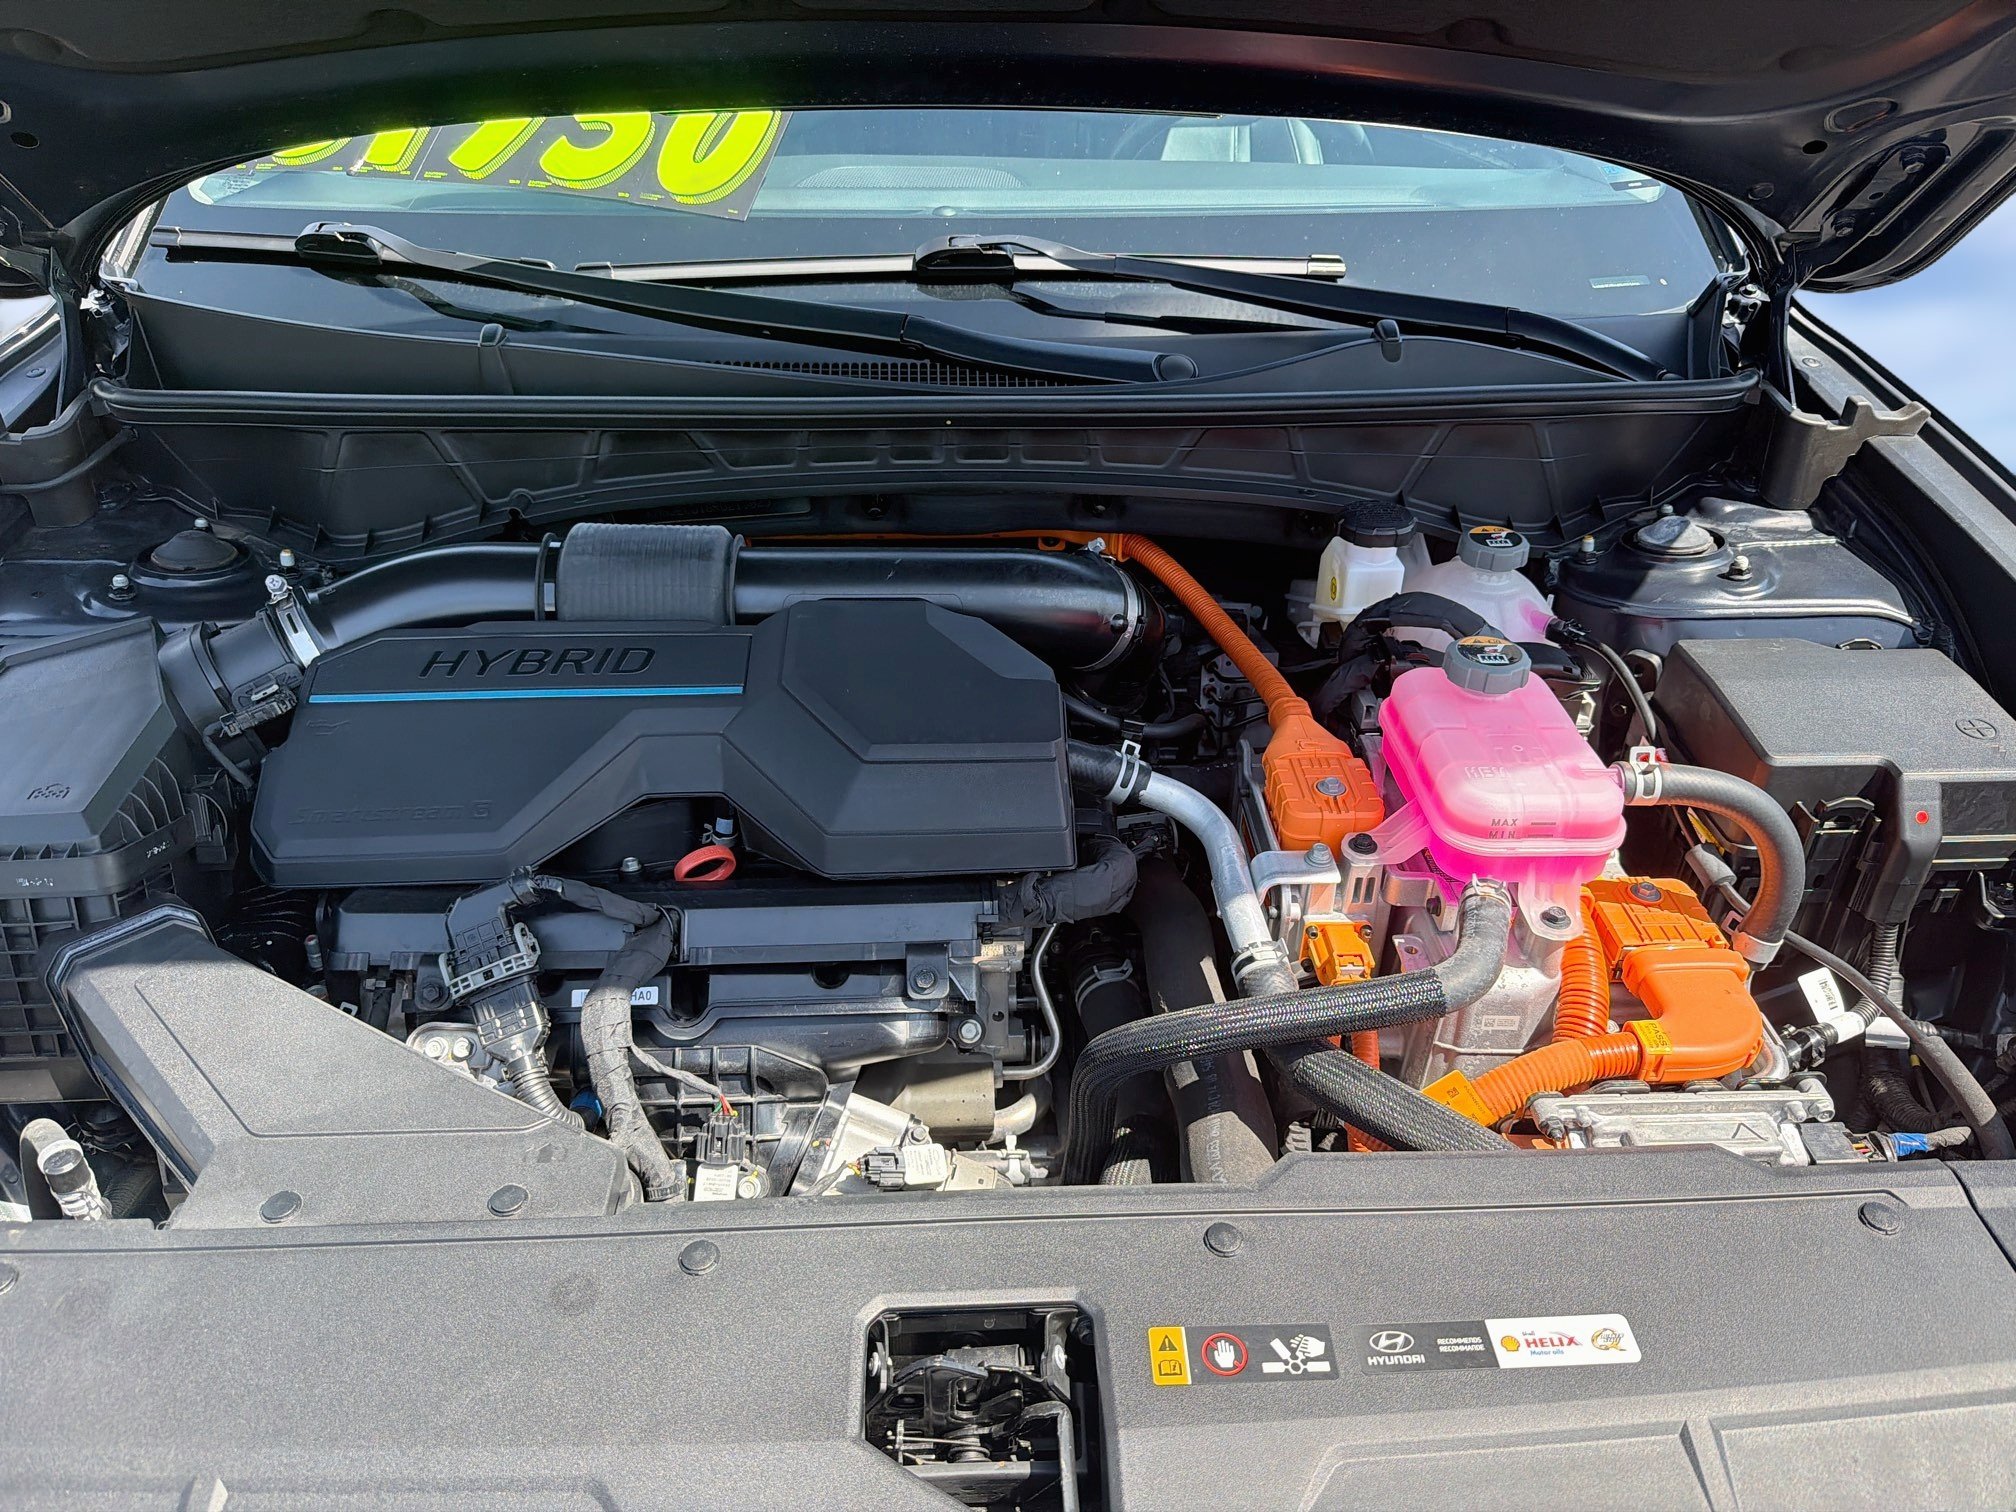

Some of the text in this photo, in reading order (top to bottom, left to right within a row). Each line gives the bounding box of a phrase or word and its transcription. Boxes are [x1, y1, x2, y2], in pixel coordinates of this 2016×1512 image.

[417, 647, 657, 678] HYBRID
[1491, 818, 1518, 827] MAX
[1488, 831, 1516, 839] MIN
[1648, 1022, 1668, 1047] PASS
[1437, 1337, 1482, 1345] RECOMMENDS
[1524, 1336, 1581, 1348] HELIX
[1367, 1354, 1426, 1365] HYUNDAI
